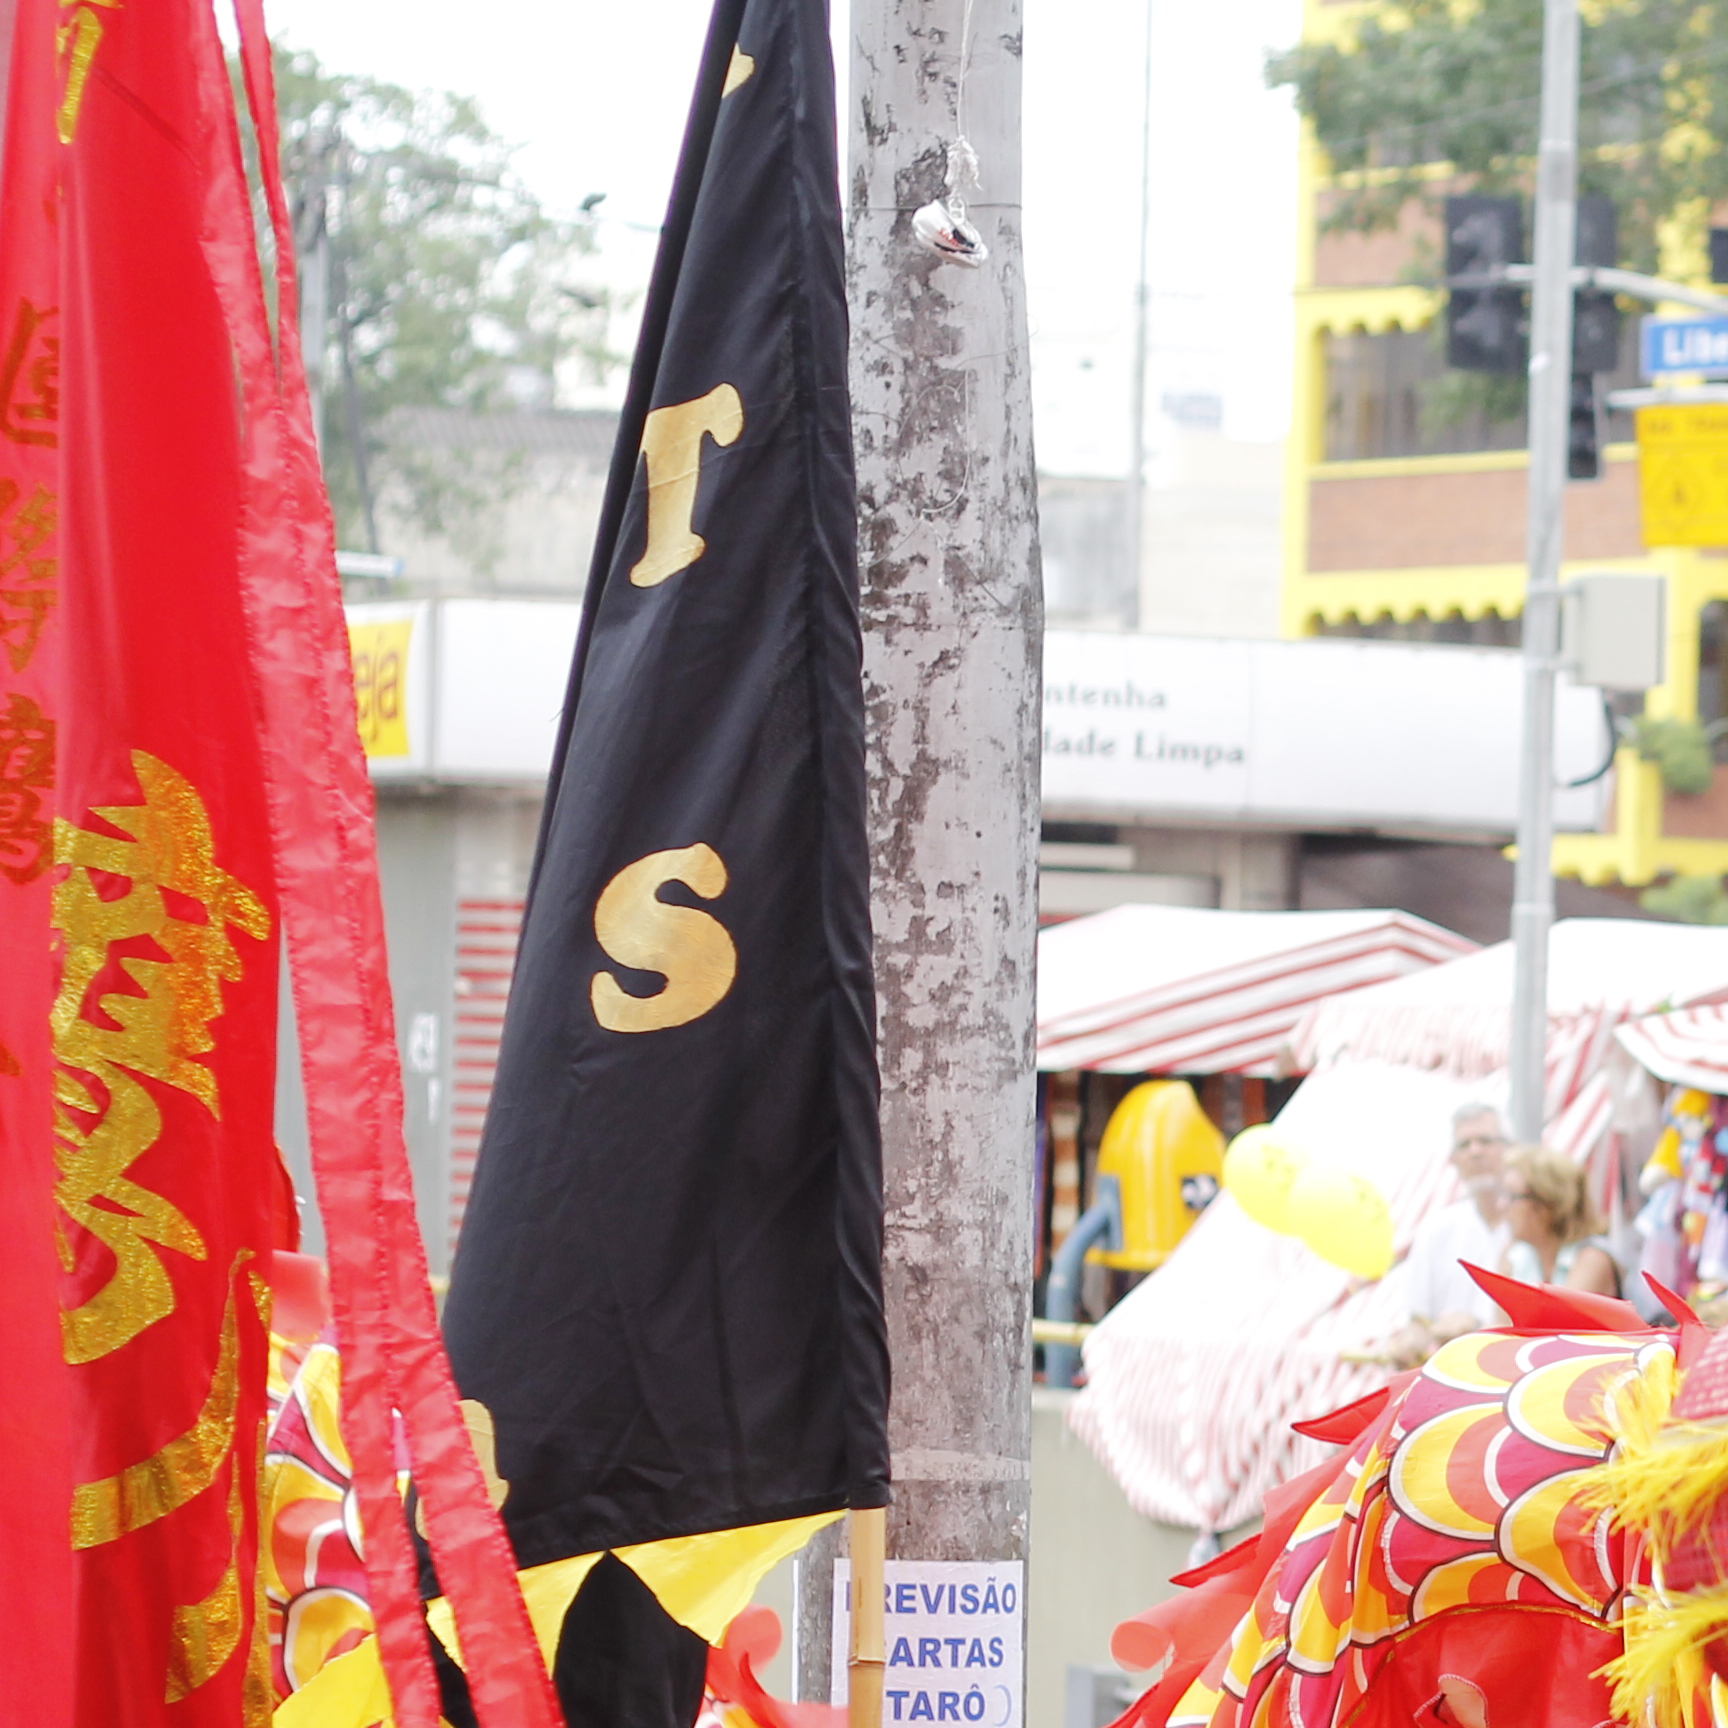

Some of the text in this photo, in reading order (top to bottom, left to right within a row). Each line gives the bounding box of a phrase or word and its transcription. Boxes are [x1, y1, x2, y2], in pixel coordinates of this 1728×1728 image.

[353, 630, 399, 743] eja
[1044, 679, 1167, 708] ntenha
[1134, 729, 1245, 769] Limpa
[846, 1577, 1017, 1615] EVISÃO
[887, 1636, 1004, 1668] ARTAS
[886, 1683, 986, 1722] TARÔ
